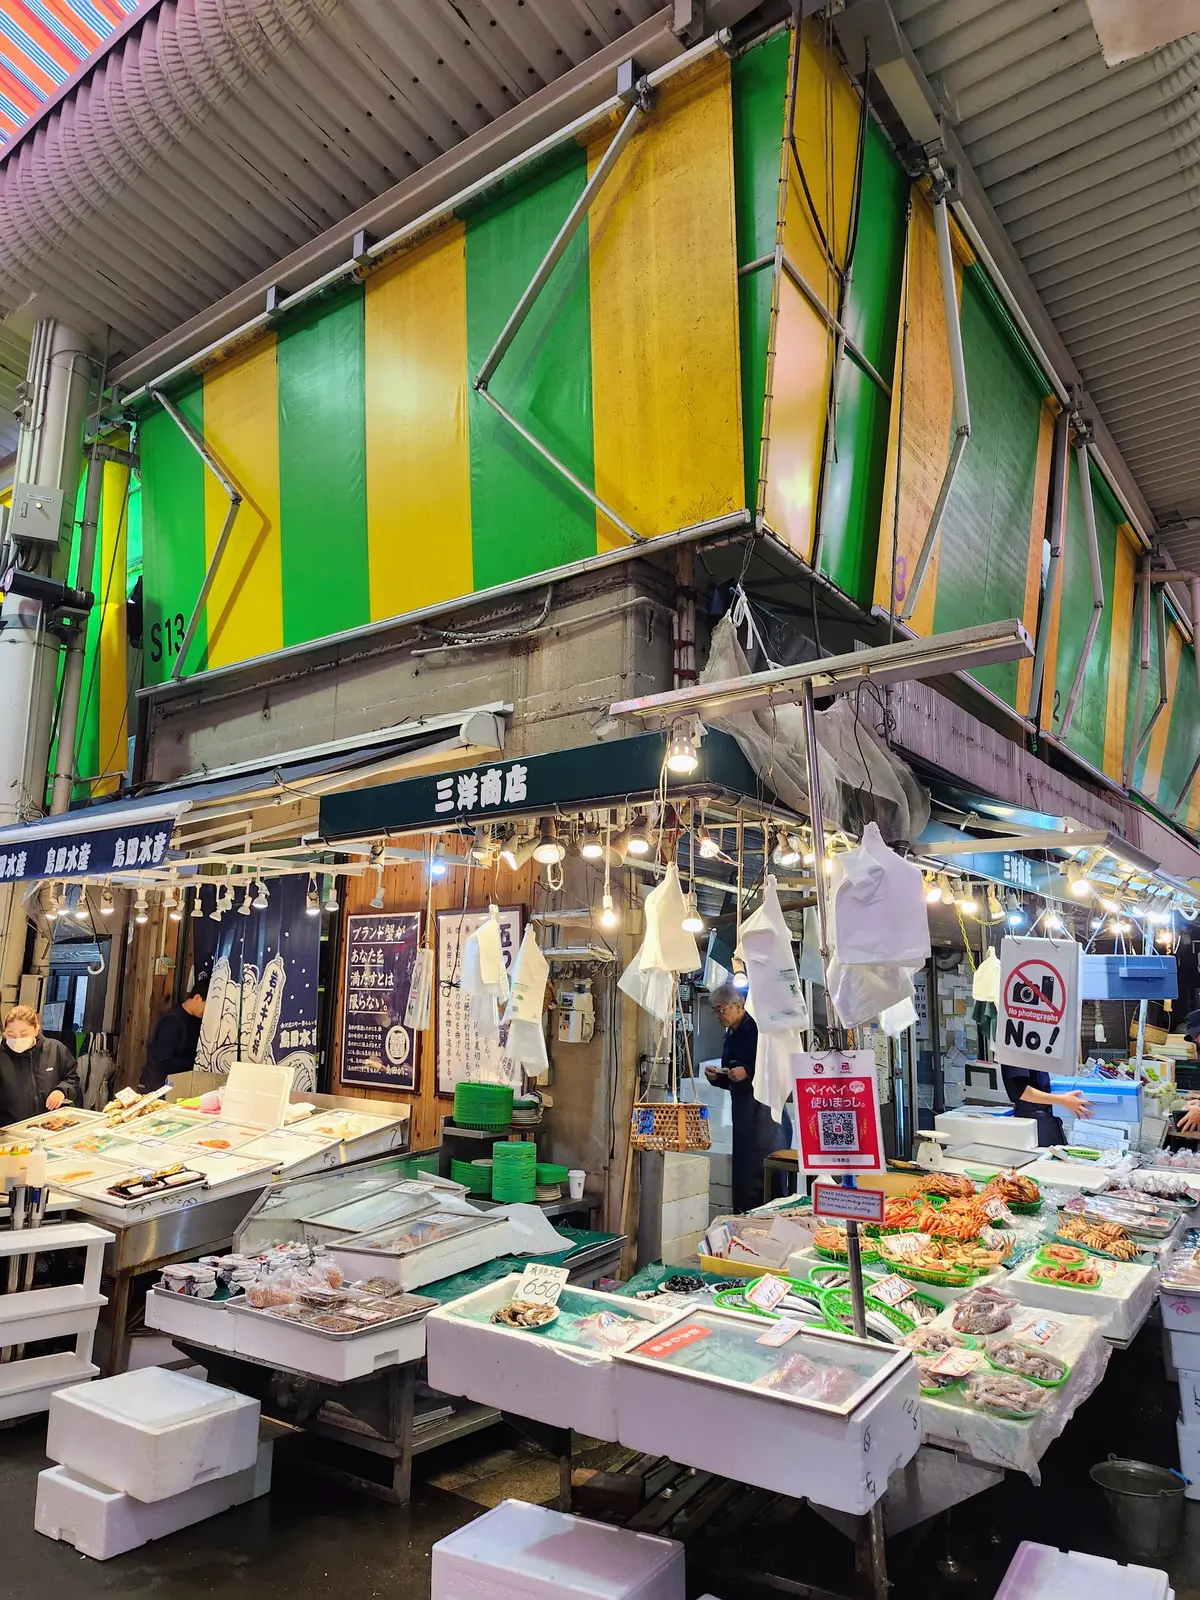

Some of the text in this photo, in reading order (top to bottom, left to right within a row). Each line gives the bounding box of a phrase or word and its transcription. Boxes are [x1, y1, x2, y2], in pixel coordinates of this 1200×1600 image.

[150, 612, 186, 663] S13
[435, 764, 528, 813] 三洋商店
[112, 831, 167, 868] 島田水産
[44, 842, 91, 875] 島田水産
[352, 924, 406, 941] ブランド蟹が
[351, 948, 385, 964] あなたを
[350, 970, 394, 987] 満たすとは
[349, 993, 388, 1011] 限らない。
[1008, 1007, 1059, 1022] No photographs
[805, 1084, 847, 1096] ペイペイ
[811, 1096, 866, 1109] 使いまっし。
[523, 1278, 561, 1298] 650
